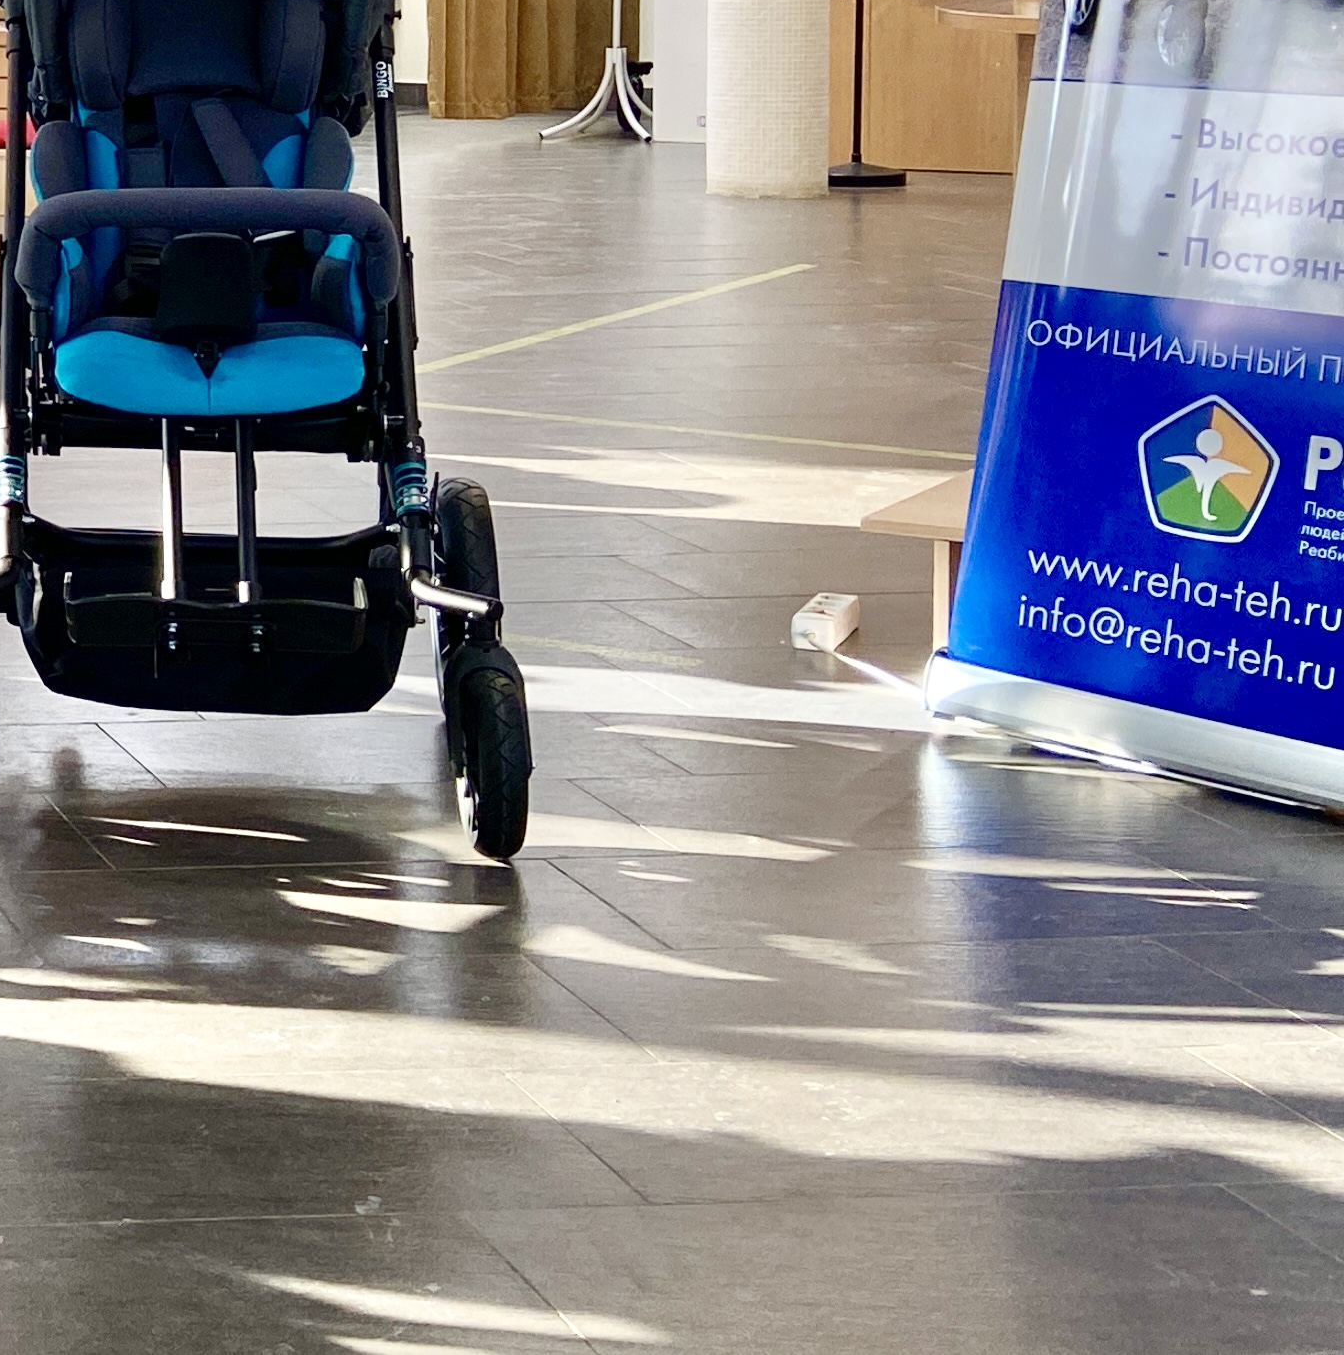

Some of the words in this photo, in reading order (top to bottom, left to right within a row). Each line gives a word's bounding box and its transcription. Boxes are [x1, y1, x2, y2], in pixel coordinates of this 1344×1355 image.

[375, 61, 389, 98] BINGO
[1027, 319, 1306, 380] ОФИЦИАЛЬНЫЙ
[1304, 435, 1344, 491] Р
[1028, 549, 1342, 632] www.reha-teh.ru
[1018, 595, 1336, 690] info@reha-teh.ru
